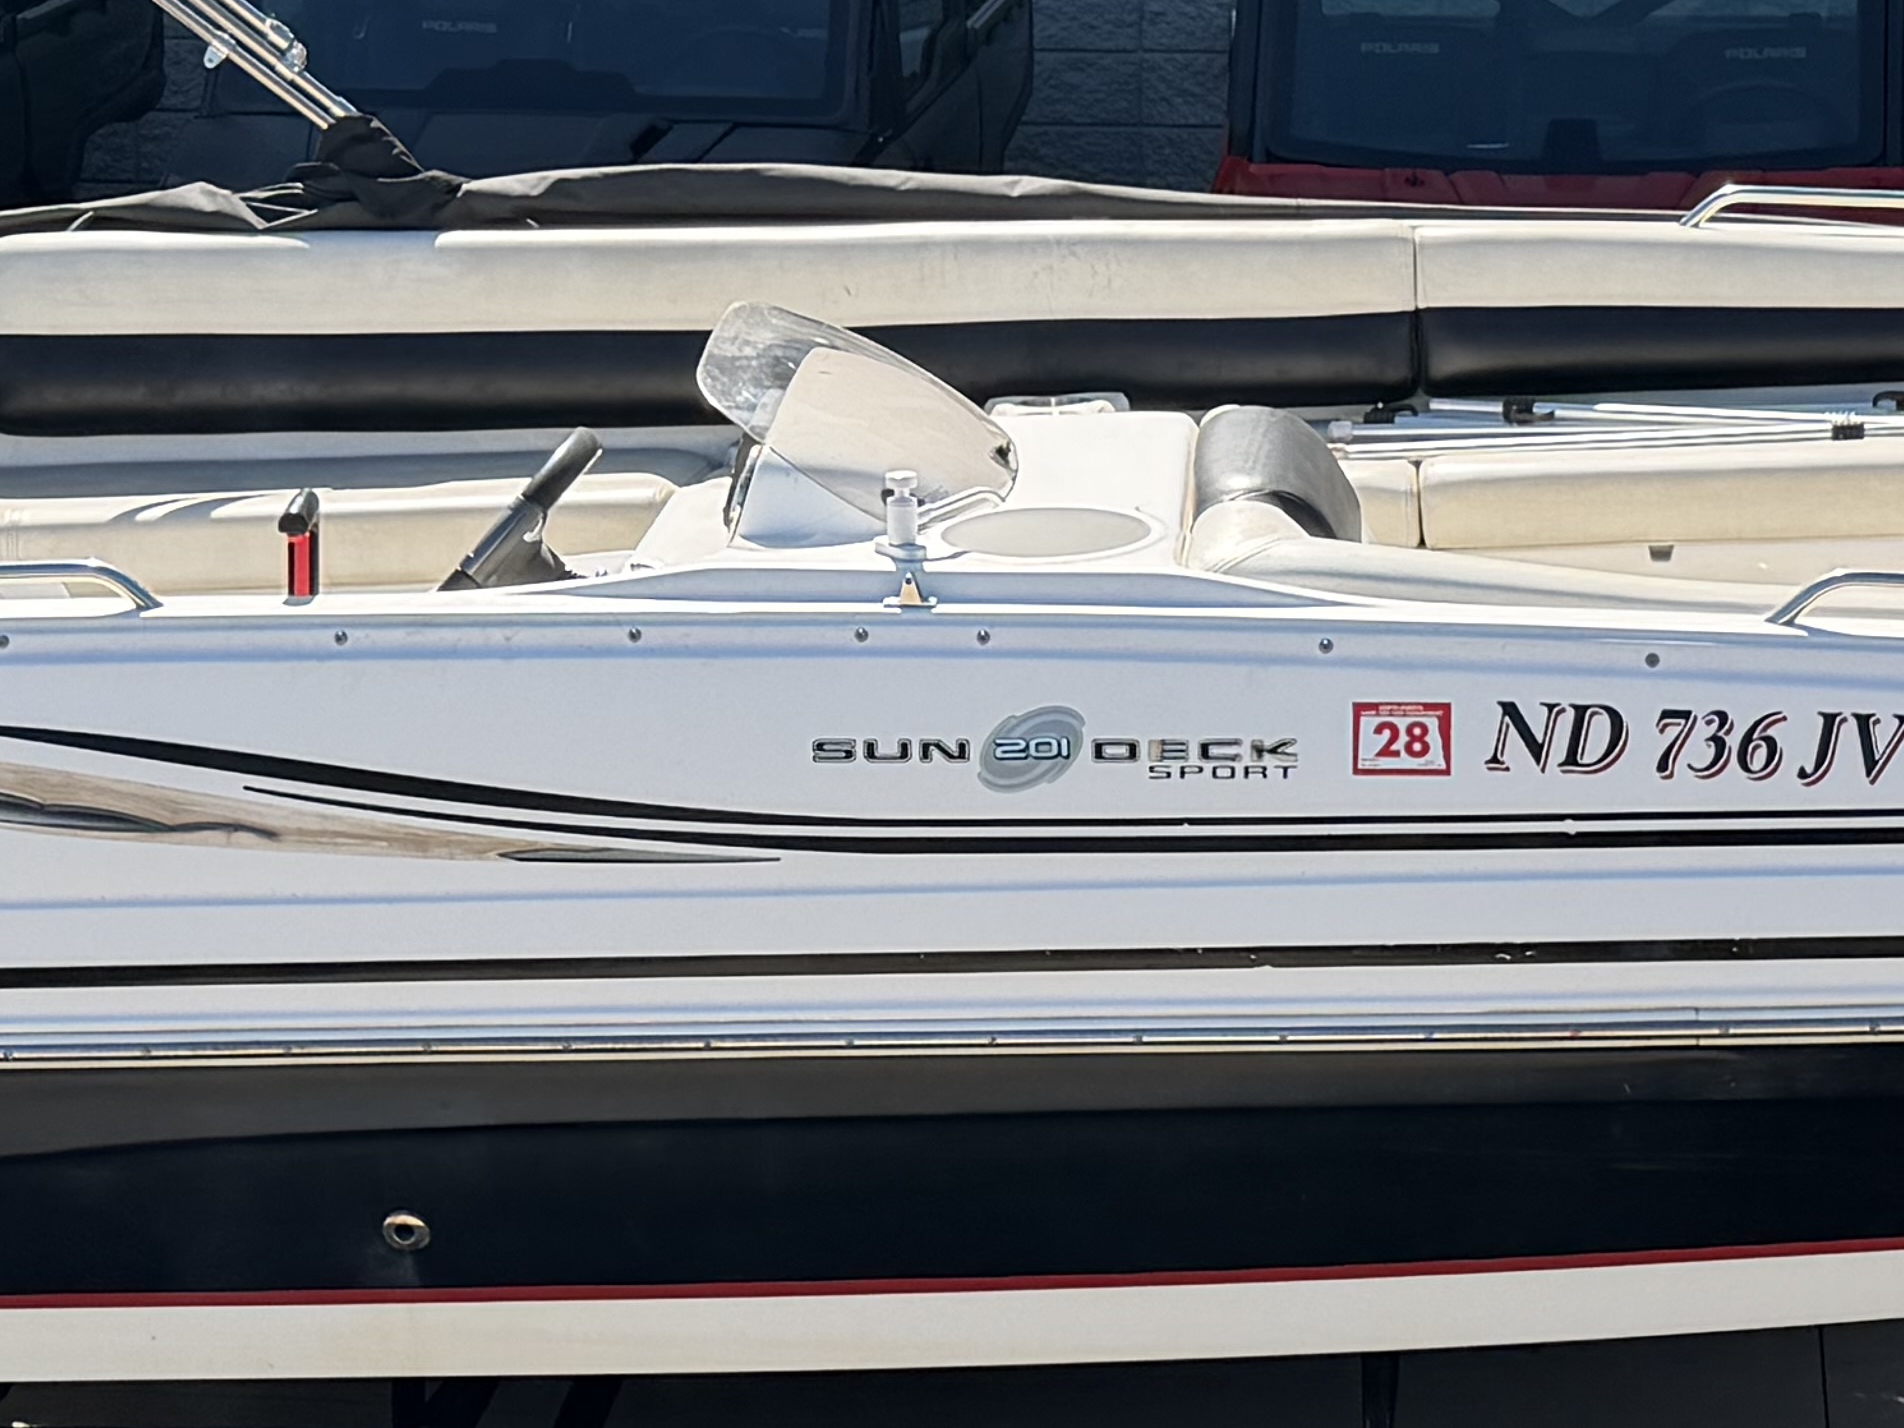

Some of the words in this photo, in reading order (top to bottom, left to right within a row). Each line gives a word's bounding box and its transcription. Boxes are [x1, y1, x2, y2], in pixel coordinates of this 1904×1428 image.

[811, 737, 971, 764] SUN
[994, 734, 1072, 761] 201
[1091, 736, 1299, 765] DECK
[1372, 719, 1432, 760] 28
[1484, 700, 1629, 774] ND
[1654, 709, 1788, 781] 736
[1147, 765, 1299, 780] SPORT
